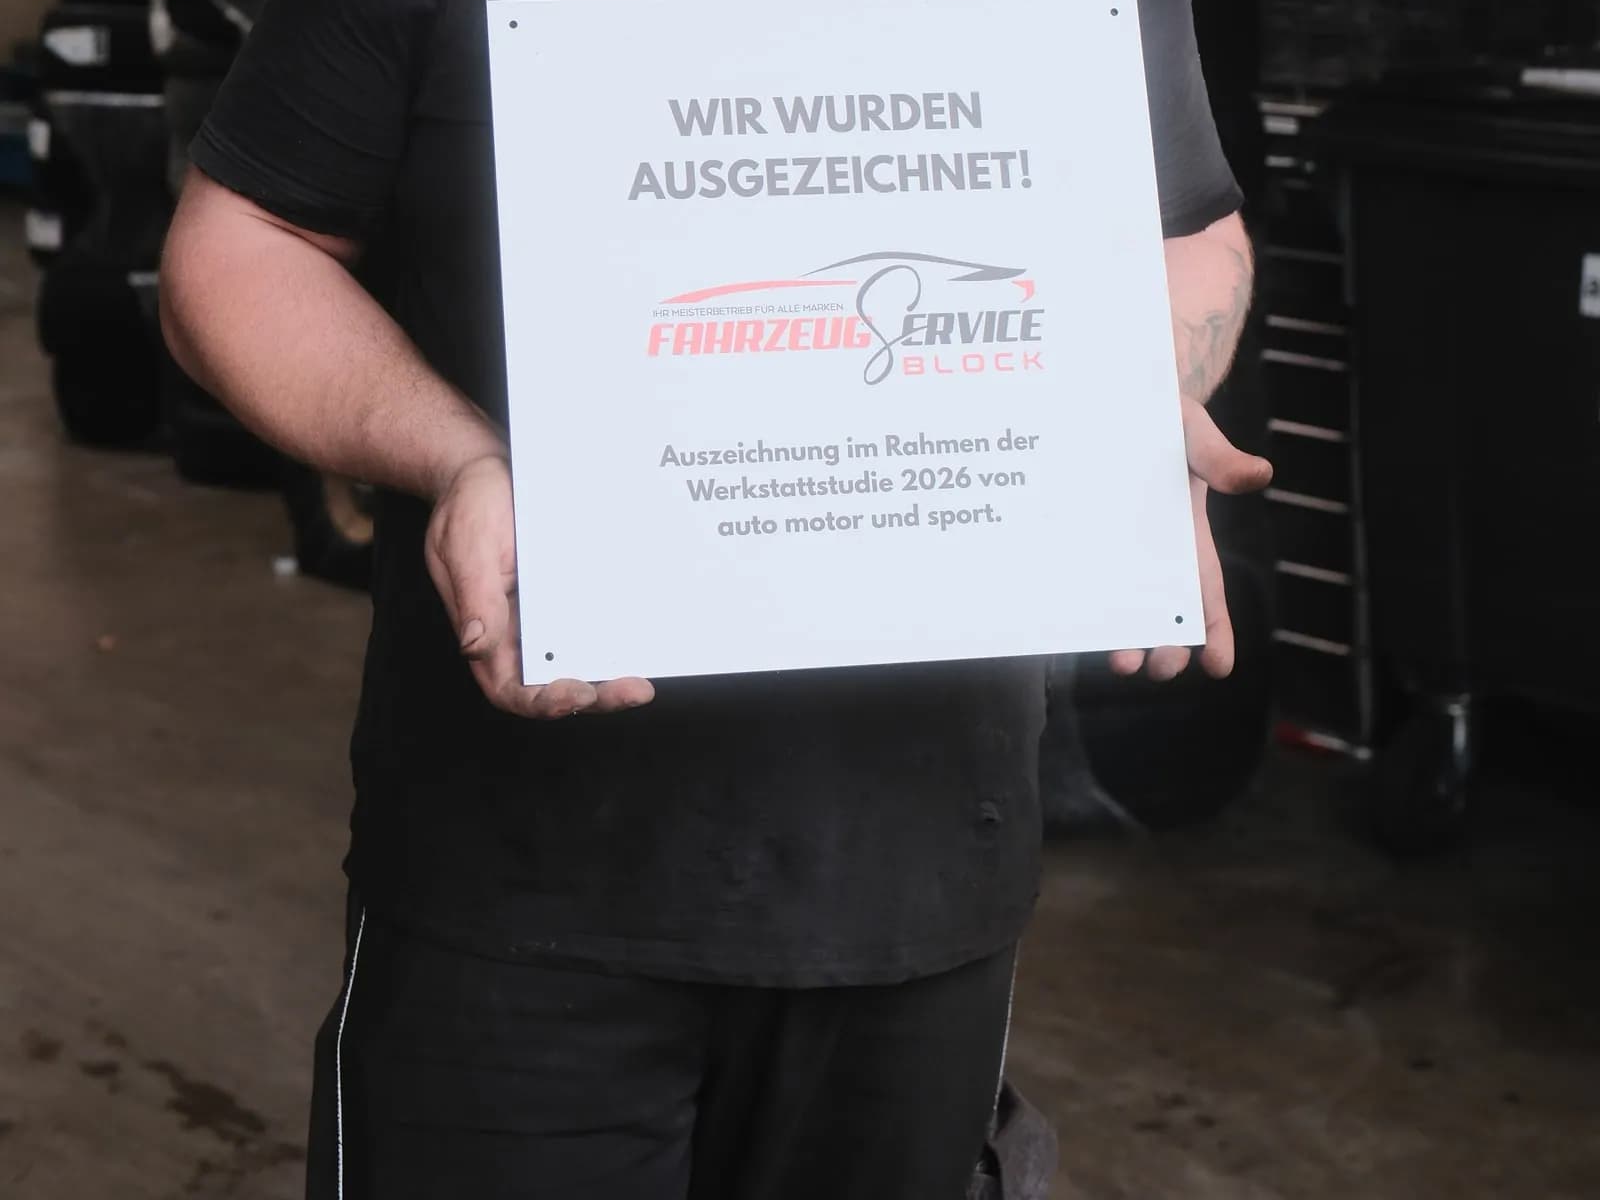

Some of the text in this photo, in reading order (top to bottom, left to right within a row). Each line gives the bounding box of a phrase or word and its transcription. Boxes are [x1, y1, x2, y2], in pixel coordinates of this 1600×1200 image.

[668, 91, 983, 136] WIR WURDEN
[628, 150, 1033, 200] AUSGEZEICHNET!
[652, 302, 844, 318] IHR MEISTERBETRIEB FÜR ALLE MARKEN
[903, 351, 1043, 375] BLOCK
[659, 428, 1040, 468] Auszeichnung im Rahmen der
[687, 467, 1026, 502] Werkstattstudie 2026 von
[717, 503, 1003, 537] auto motor und sport.
